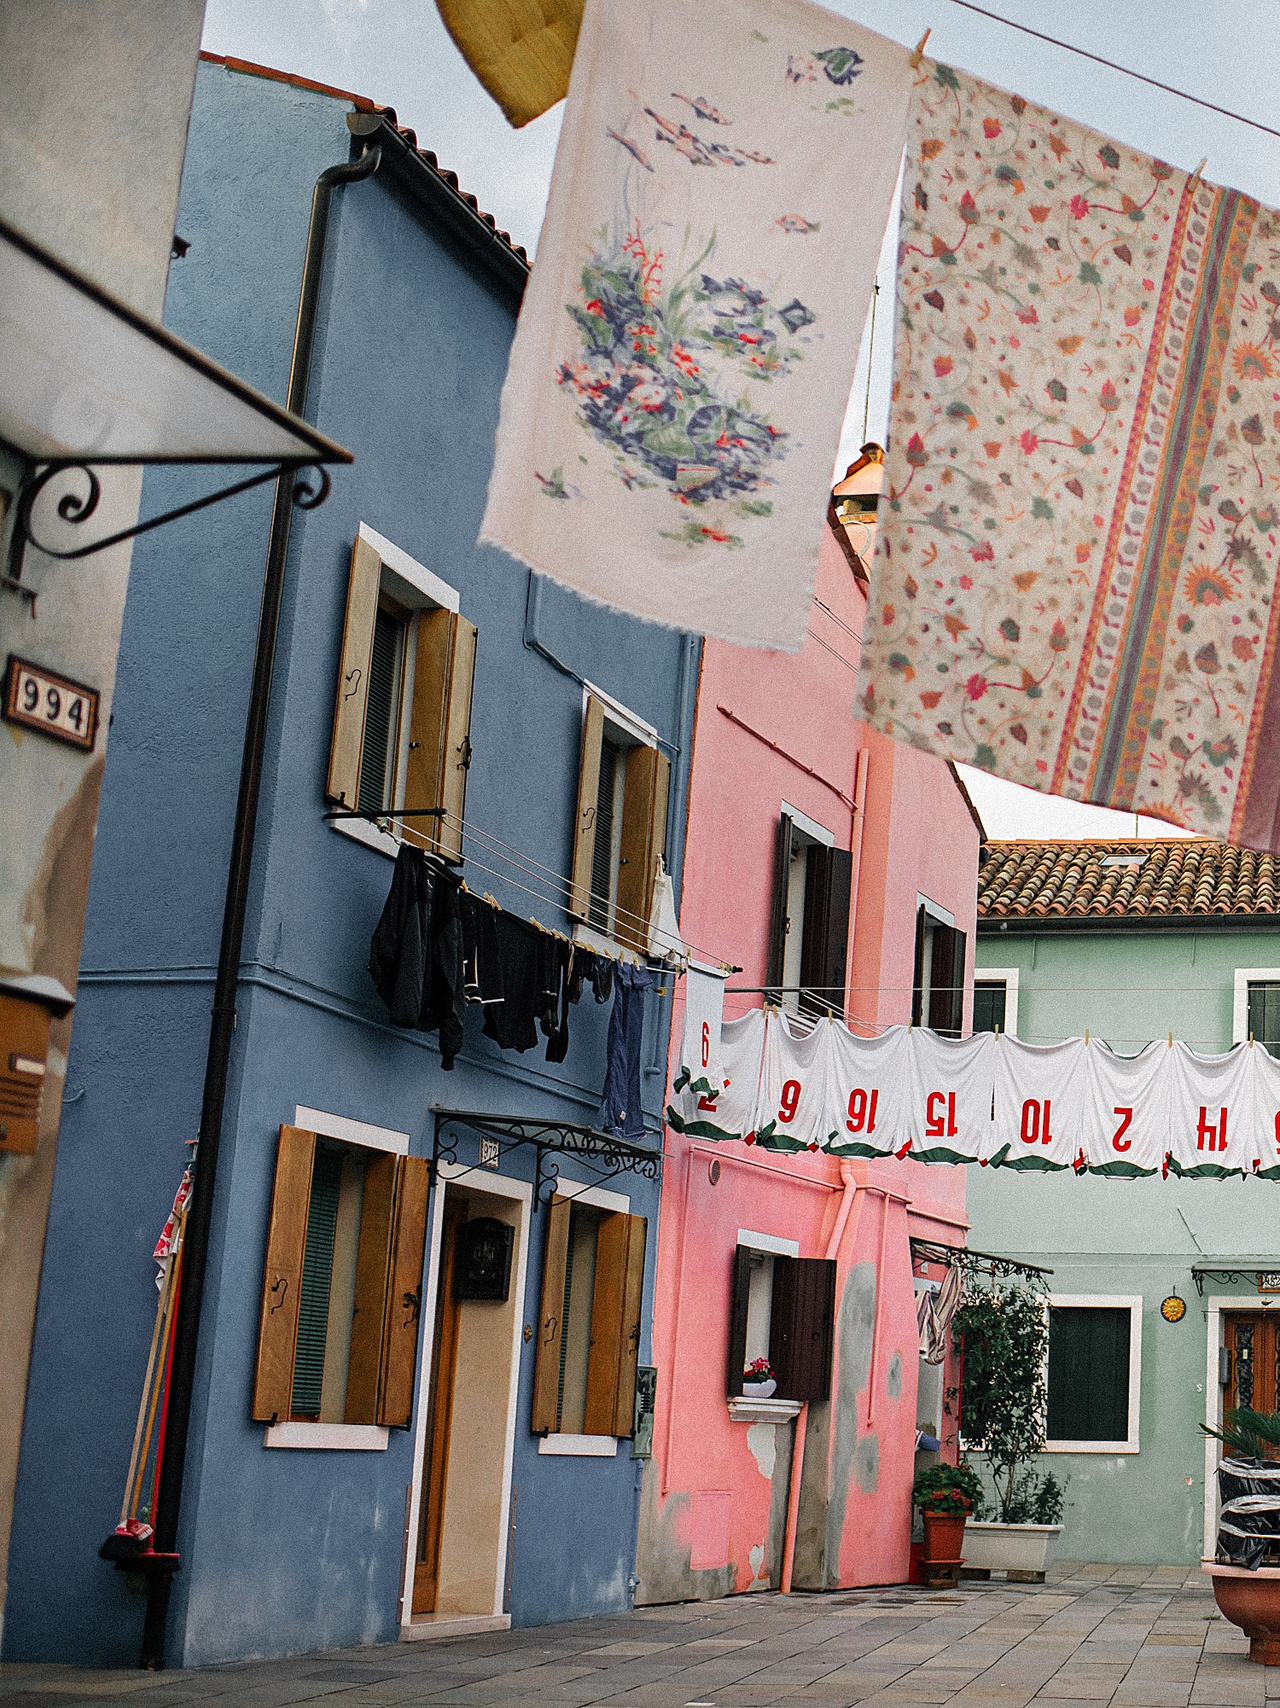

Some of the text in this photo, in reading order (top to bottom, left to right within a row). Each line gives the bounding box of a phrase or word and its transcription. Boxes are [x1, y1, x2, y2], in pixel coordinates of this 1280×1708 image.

[24, 678, 83, 732] 994
[846, 1088, 879, 1134] 16
[925, 1091, 958, 1137] 15
[1020, 1098, 1053, 1145] 10
[1112, 1106, 1133, 1152] 2
[1196, 1106, 1229, 1152] 14
